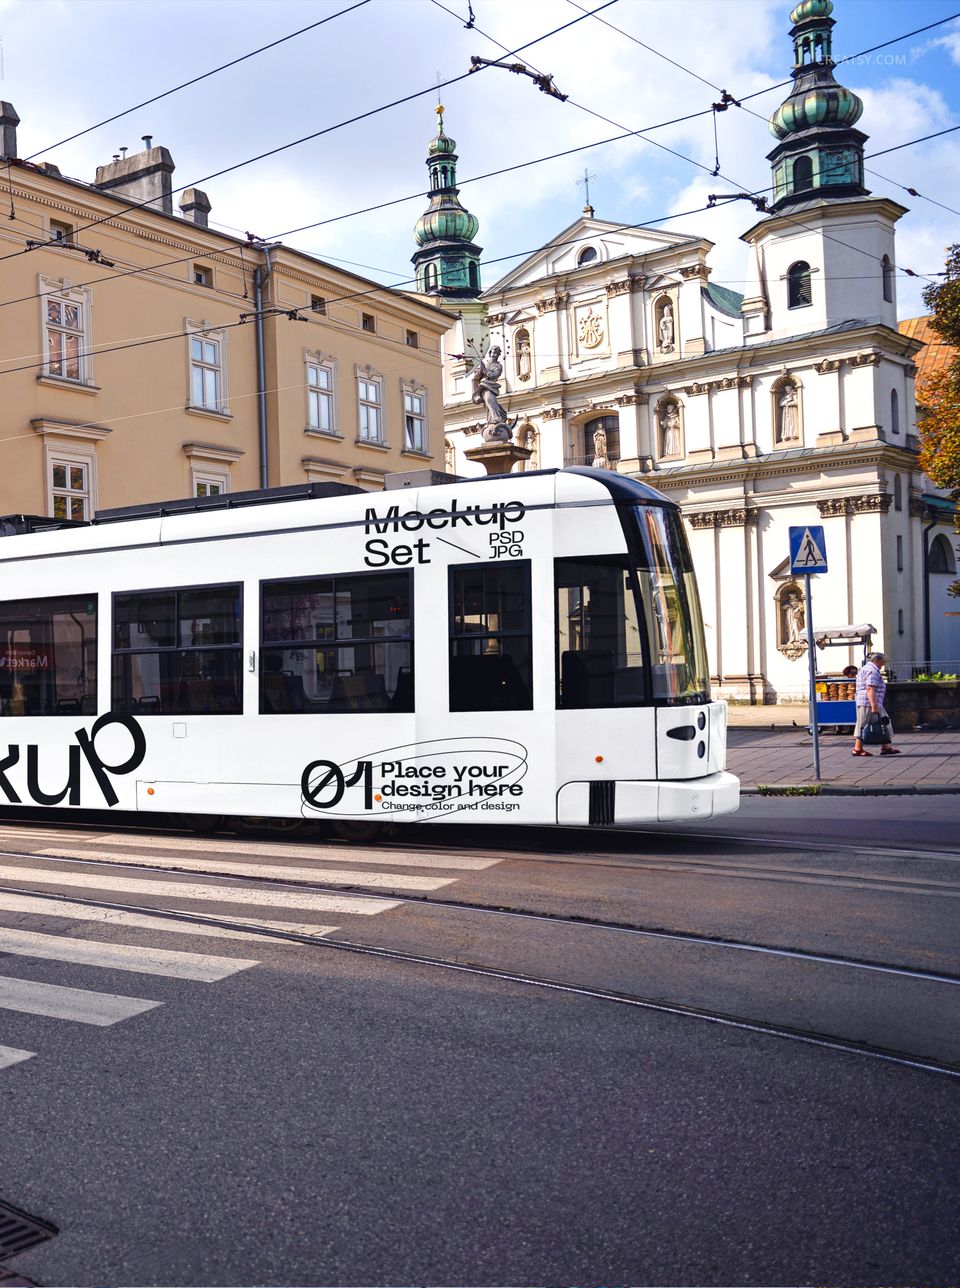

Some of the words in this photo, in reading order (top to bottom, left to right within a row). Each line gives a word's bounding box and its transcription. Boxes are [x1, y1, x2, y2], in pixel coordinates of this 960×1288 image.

[364, 498, 525, 535] Mockup
[489, 530, 524, 546] PSD
[363, 537, 431, 568] Set
[488, 545, 523, 559] JPG
[381, 761, 446, 778] Place
[453, 765, 509, 782] your
[301, 759, 373, 810] 01
[381, 780, 462, 800] design
[468, 780, 523, 796] here
[381, 801, 422, 811] Change
[425, 801, 454, 810] color
[457, 801, 478, 811] and
[481, 802, 520, 811] design
